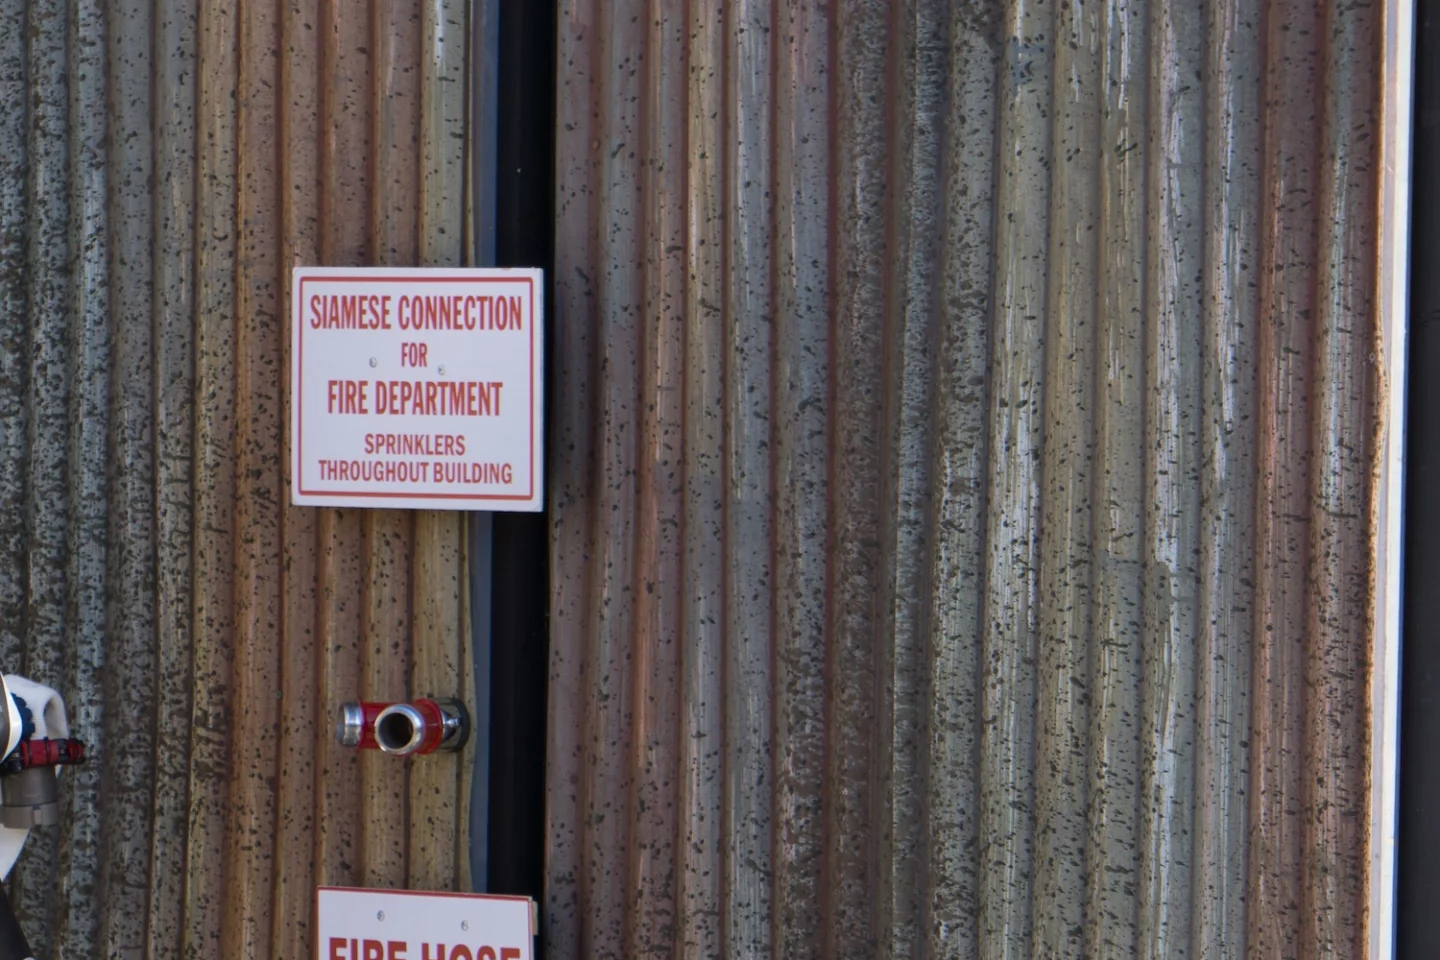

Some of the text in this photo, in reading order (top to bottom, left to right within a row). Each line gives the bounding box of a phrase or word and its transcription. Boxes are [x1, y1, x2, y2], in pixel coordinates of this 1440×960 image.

[310, 294, 523, 331] SIAMESE CONNECTION
[400, 342, 428, 368] FOR
[327, 380, 504, 416] FIRE DEPARTMENT
[364, 433, 466, 456] SPRINKLERS
[318, 459, 513, 484] THROUGHOUT BUILDING
